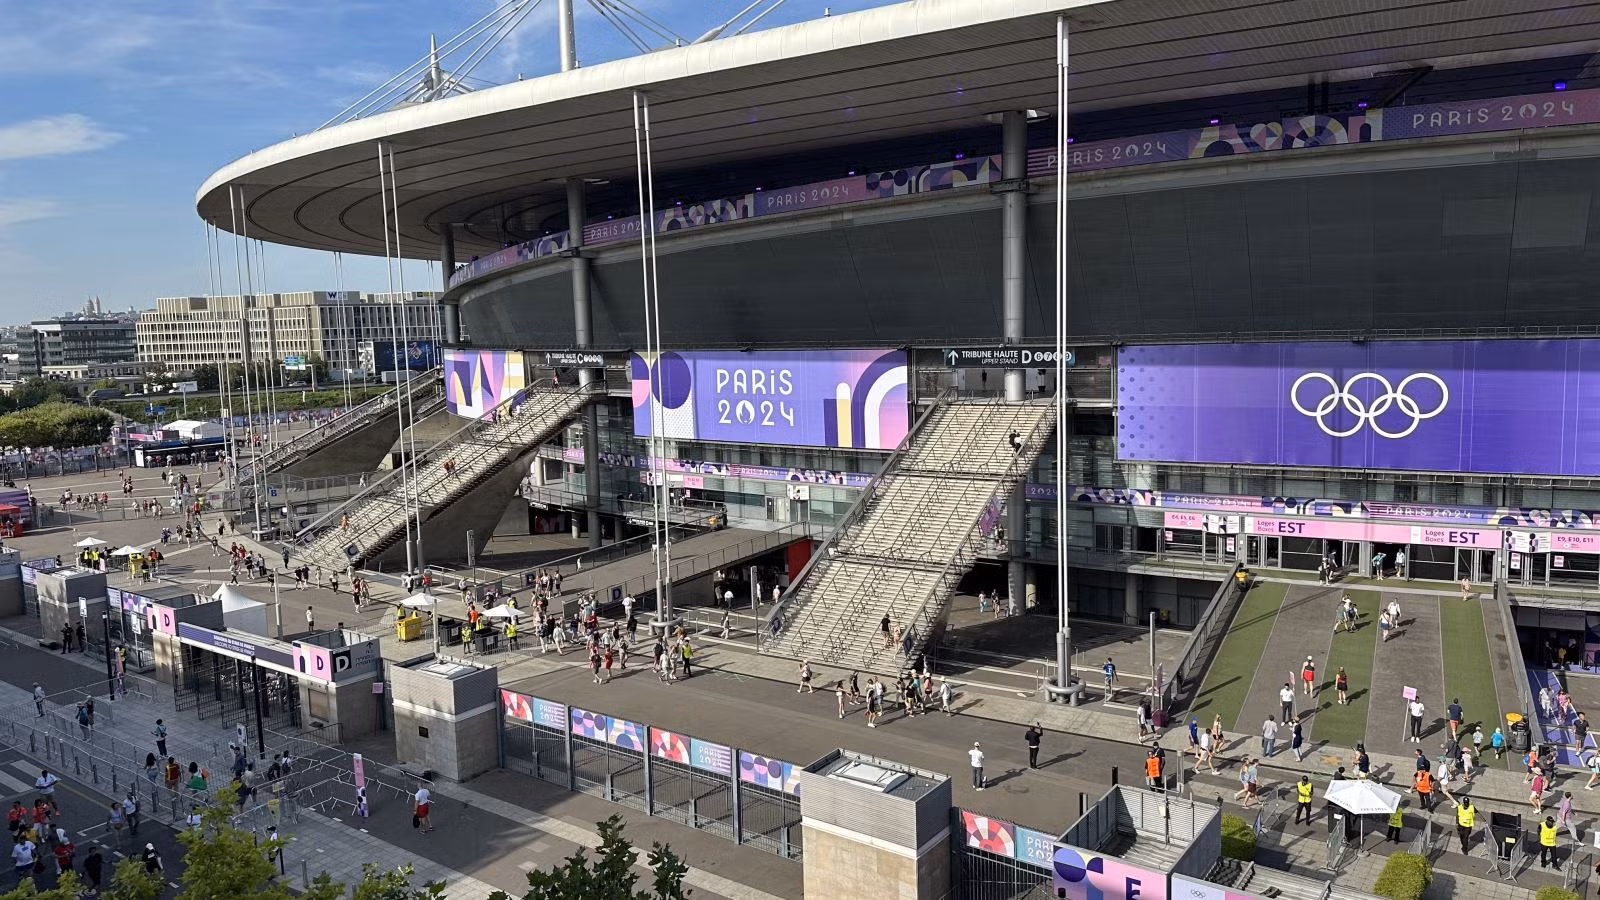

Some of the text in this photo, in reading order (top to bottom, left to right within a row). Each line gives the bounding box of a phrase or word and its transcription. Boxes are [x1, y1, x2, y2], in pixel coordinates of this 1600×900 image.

[1413, 101, 1574, 128] PARiS 2024
[1047, 141, 1166, 168] PRiS 2024
[811, 186, 849, 200] 2024
[961, 350, 992, 358] TRIBUNE
[993, 350, 1019, 358] HAUTE
[1021, 350, 1032, 364] D
[716, 368, 793, 396] PARiS
[717, 399, 795, 427] 2024
[1278, 521, 1306, 534] EST
[1425, 529, 1445, 537] Loges
[1448, 531, 1480, 544] EST
[164, 613, 170, 627] D
[316, 655, 323, 671] D
[335, 655, 350, 673] D
[1027, 836, 1054, 852] PARi
[1027, 847, 1053, 862] 202
